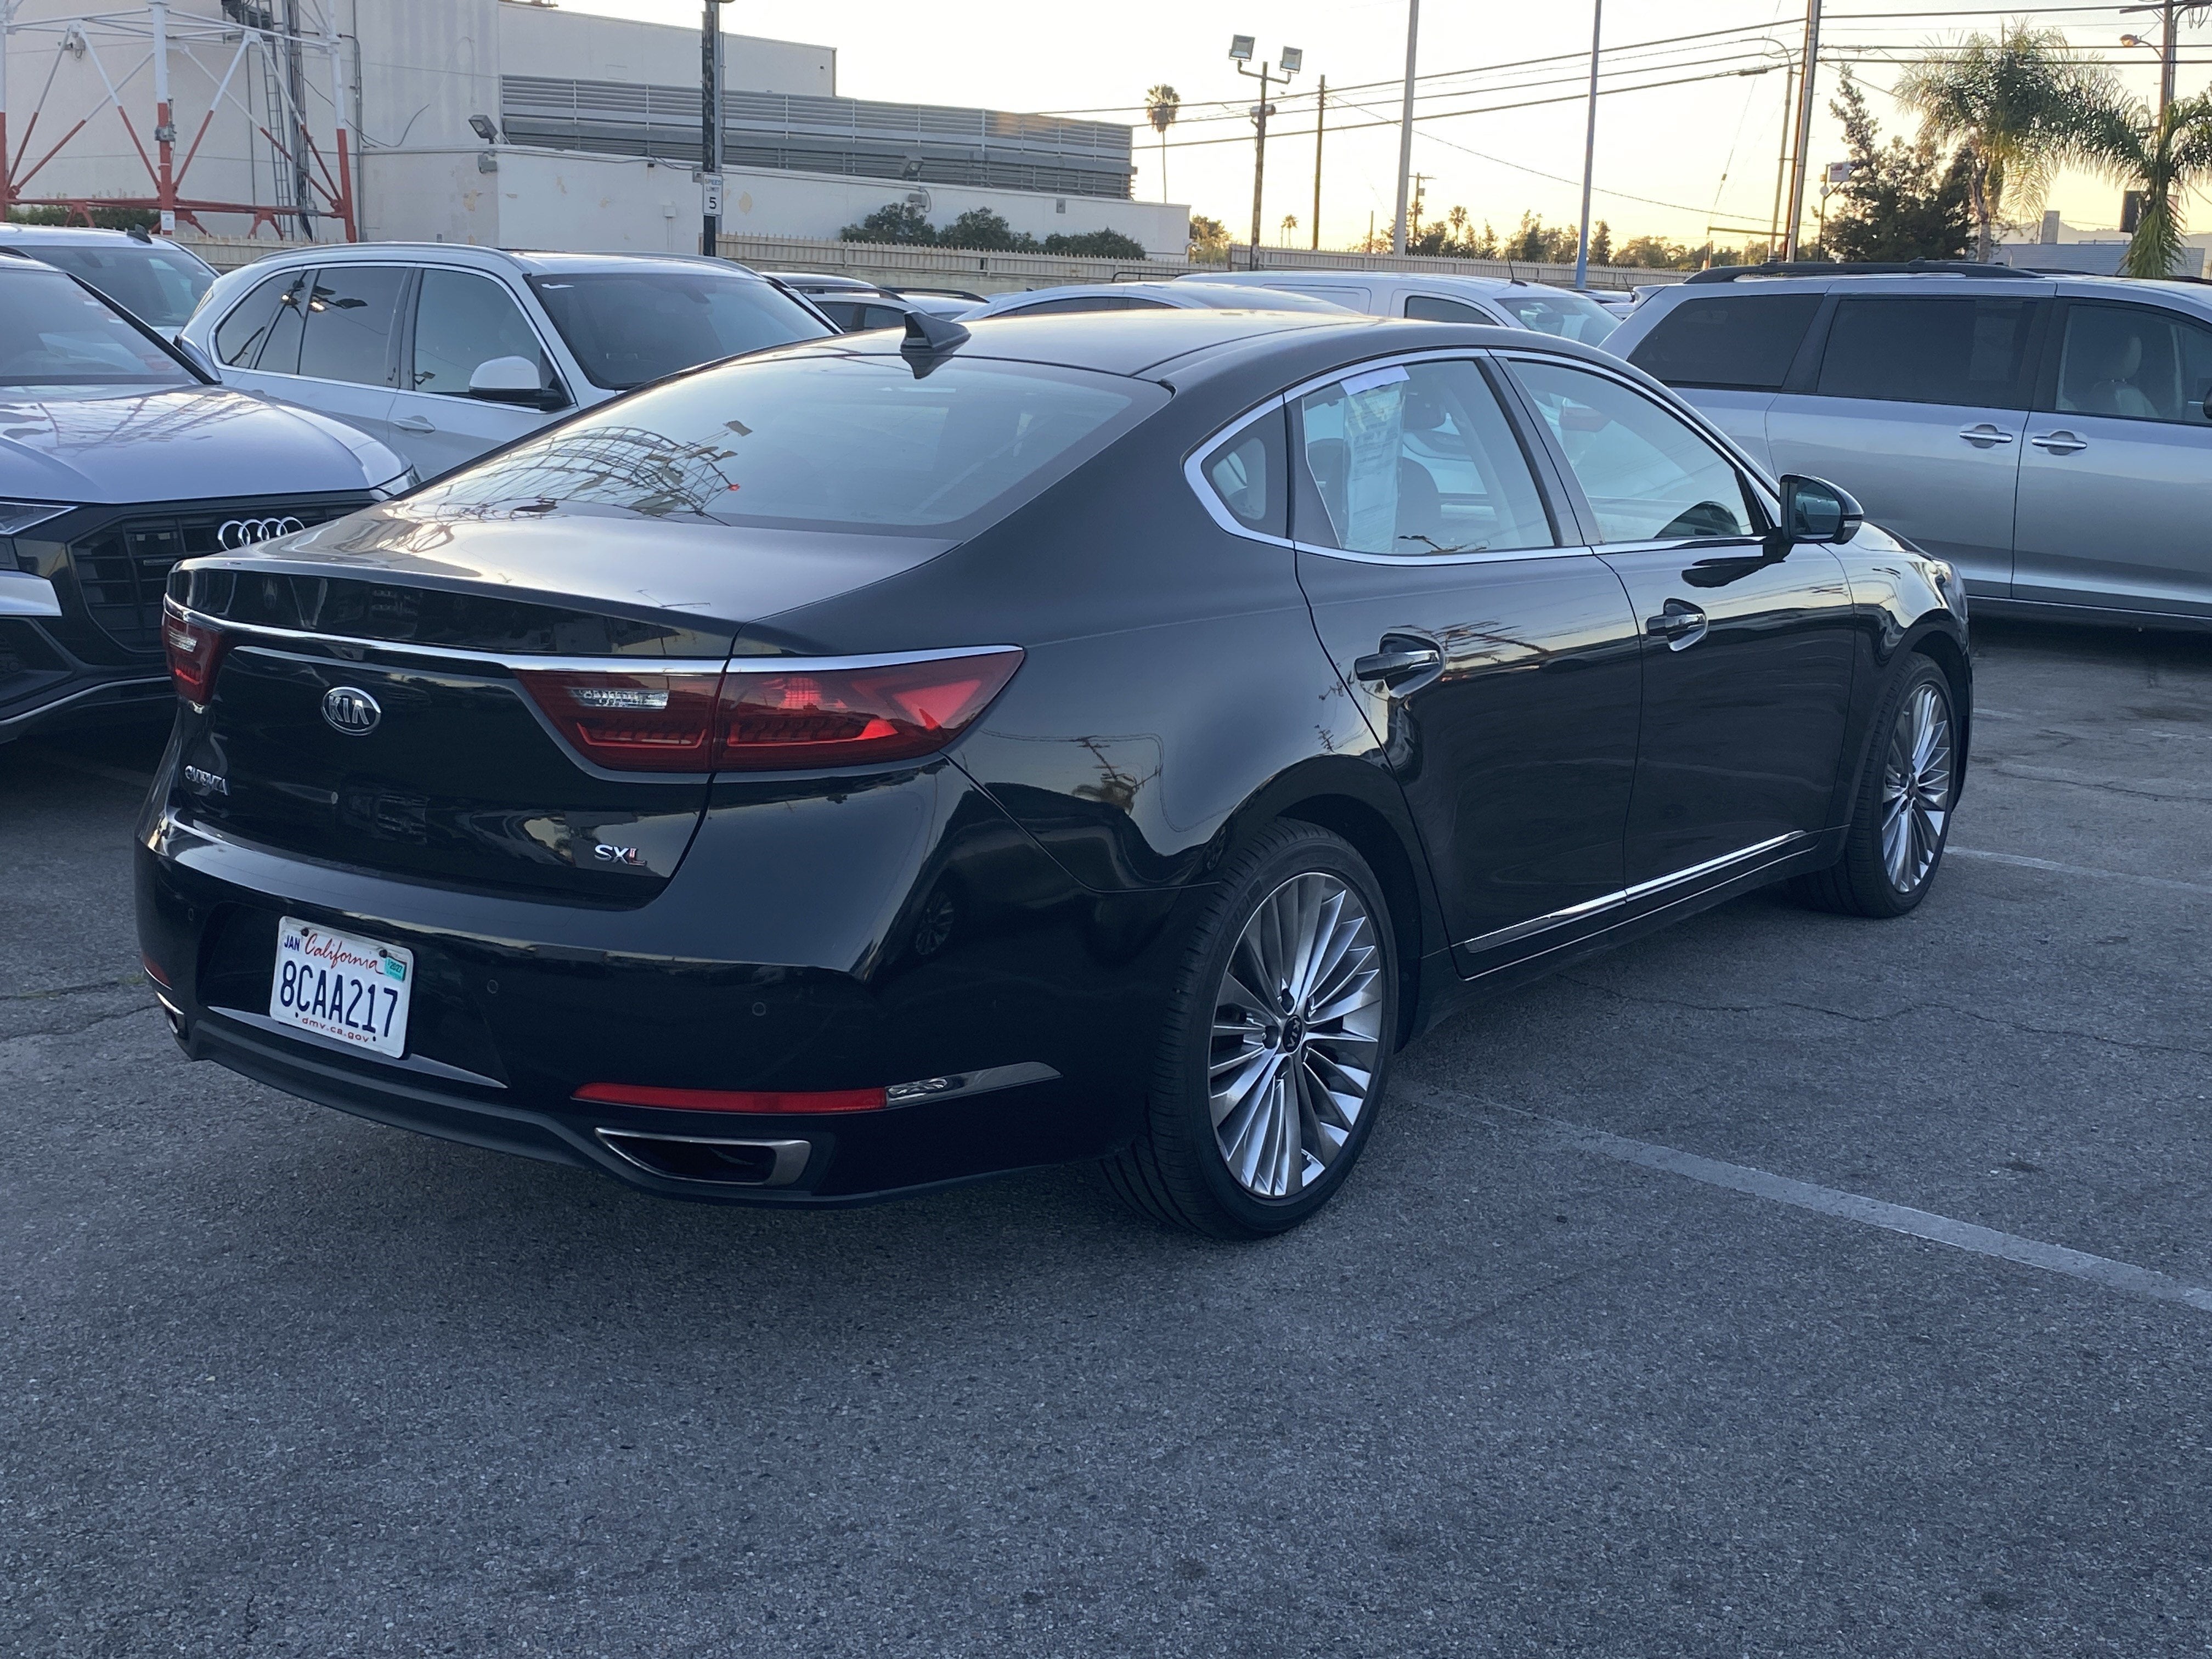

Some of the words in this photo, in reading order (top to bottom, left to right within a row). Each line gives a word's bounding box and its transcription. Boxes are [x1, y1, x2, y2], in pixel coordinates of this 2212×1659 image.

[709, 196, 716, 210] 5
[329, 696, 369, 725] KIA
[284, 935, 301, 952] JAN
[305, 933, 385, 974] California
[280, 960, 398, 1038] 8CAA217
[302, 1017, 369, 1042] dmv.ca.gov
